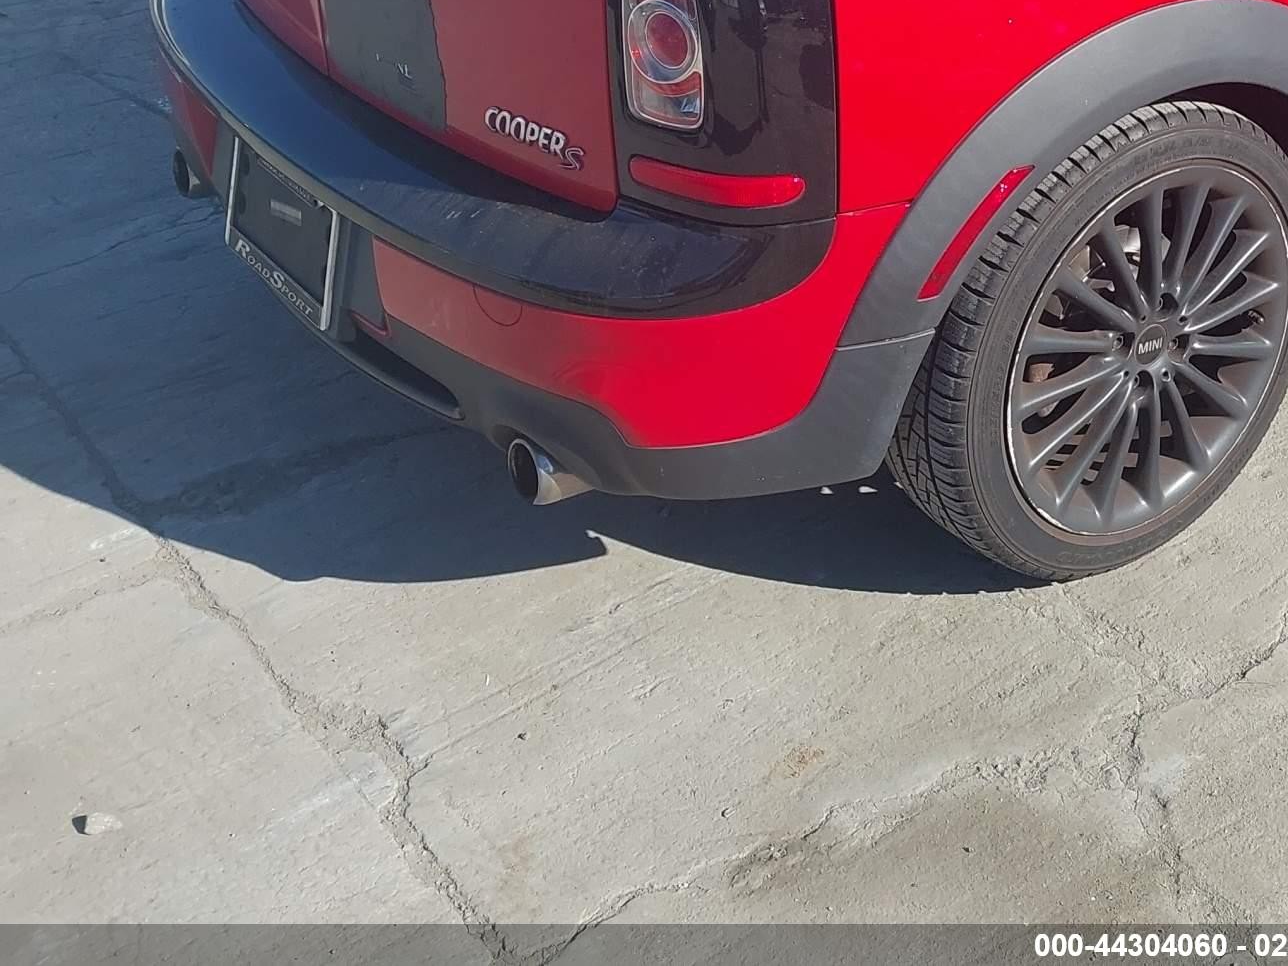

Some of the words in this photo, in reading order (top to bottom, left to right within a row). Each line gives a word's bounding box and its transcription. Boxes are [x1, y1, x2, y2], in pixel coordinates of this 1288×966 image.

[484, 106, 566, 160] COOPER
[560, 147, 585, 171] S
[1138, 337, 1163, 355] MINI
